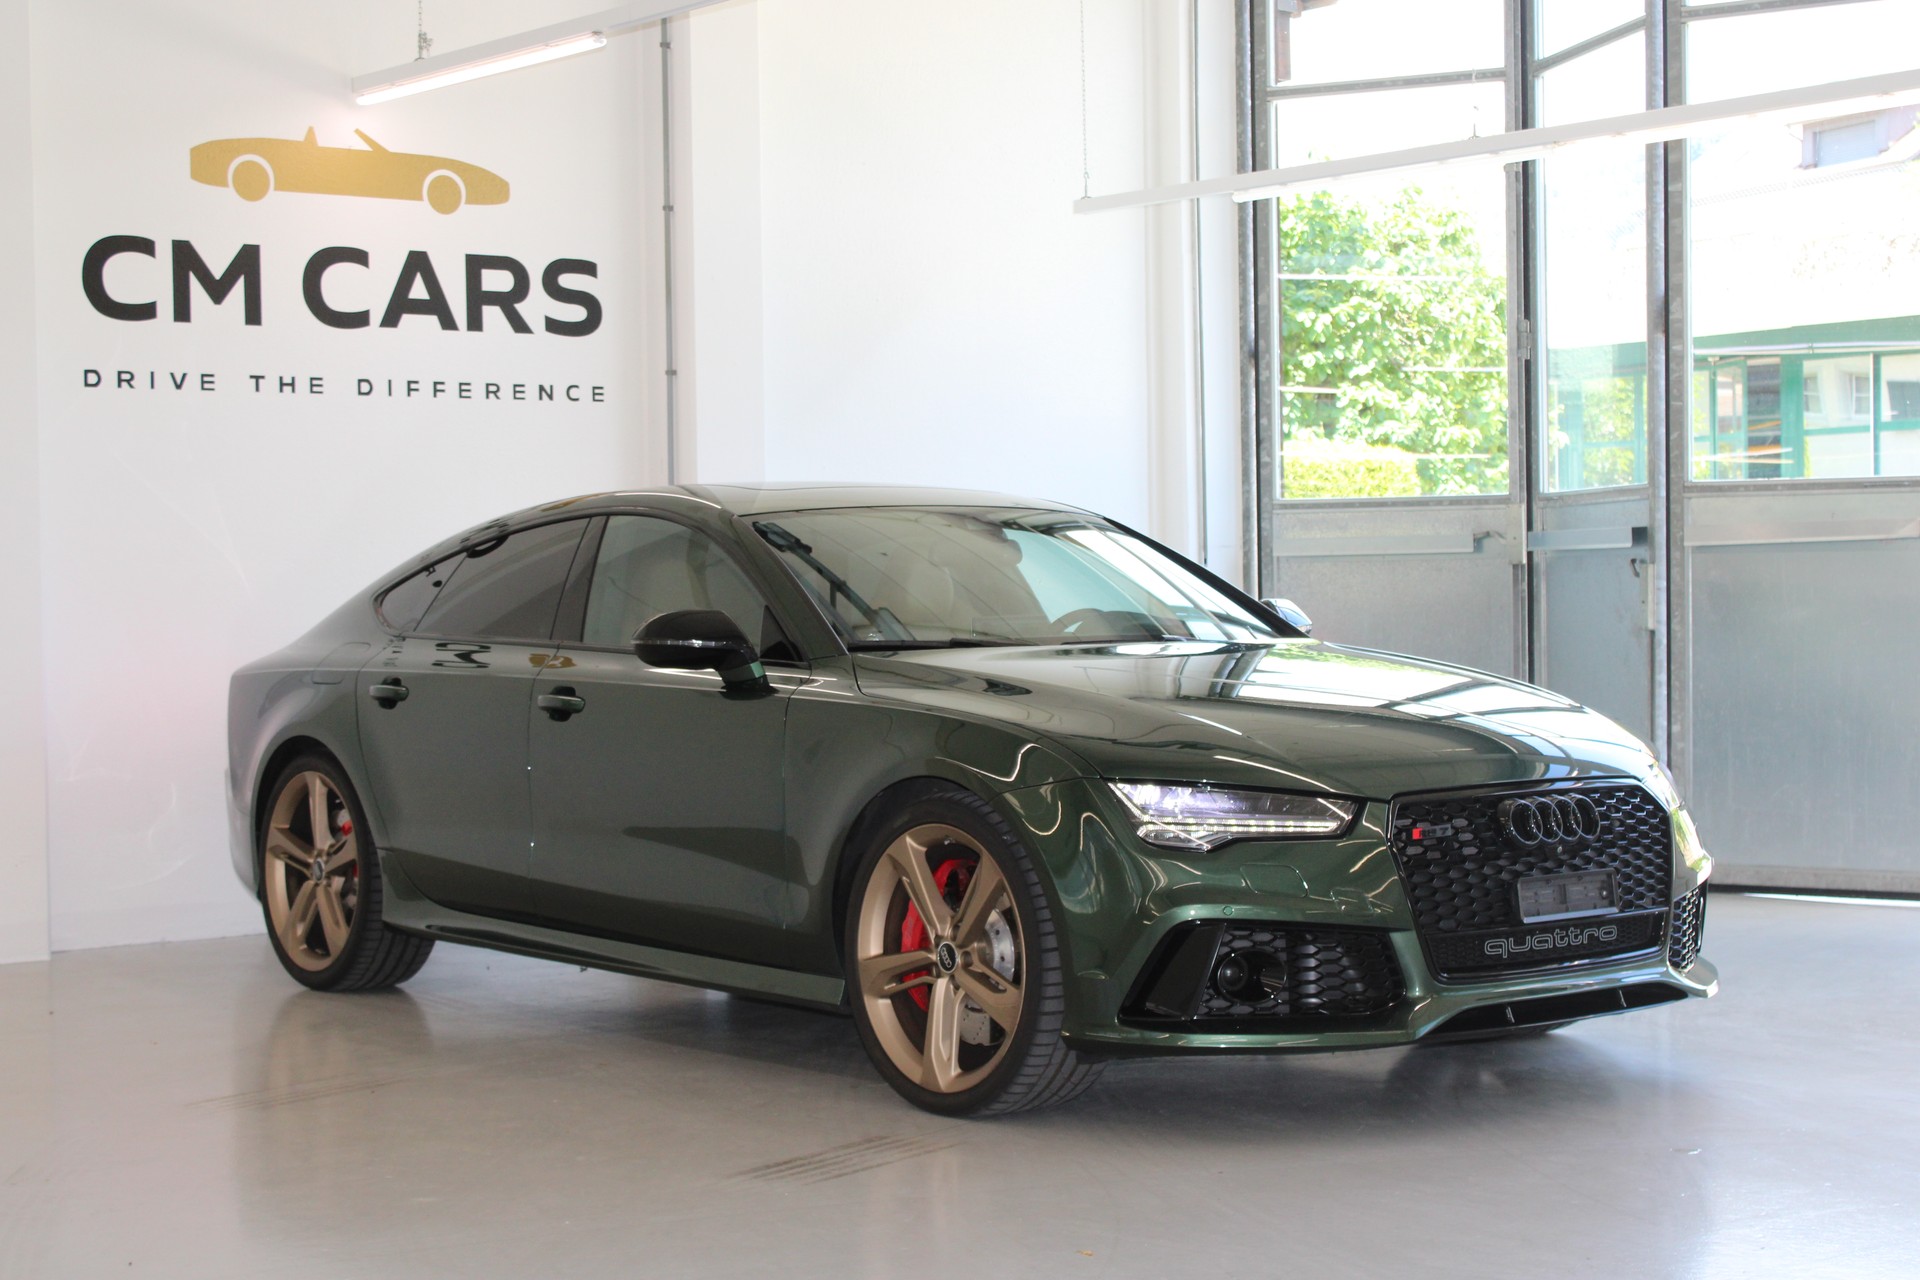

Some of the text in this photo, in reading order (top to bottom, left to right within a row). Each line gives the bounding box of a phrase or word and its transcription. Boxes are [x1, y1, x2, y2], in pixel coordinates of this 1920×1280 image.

[82, 234, 603, 337] CM CARS
[83, 369, 605, 402] DRIVE THE DIFFERENCE
[1484, 925, 1618, 958] quattro
